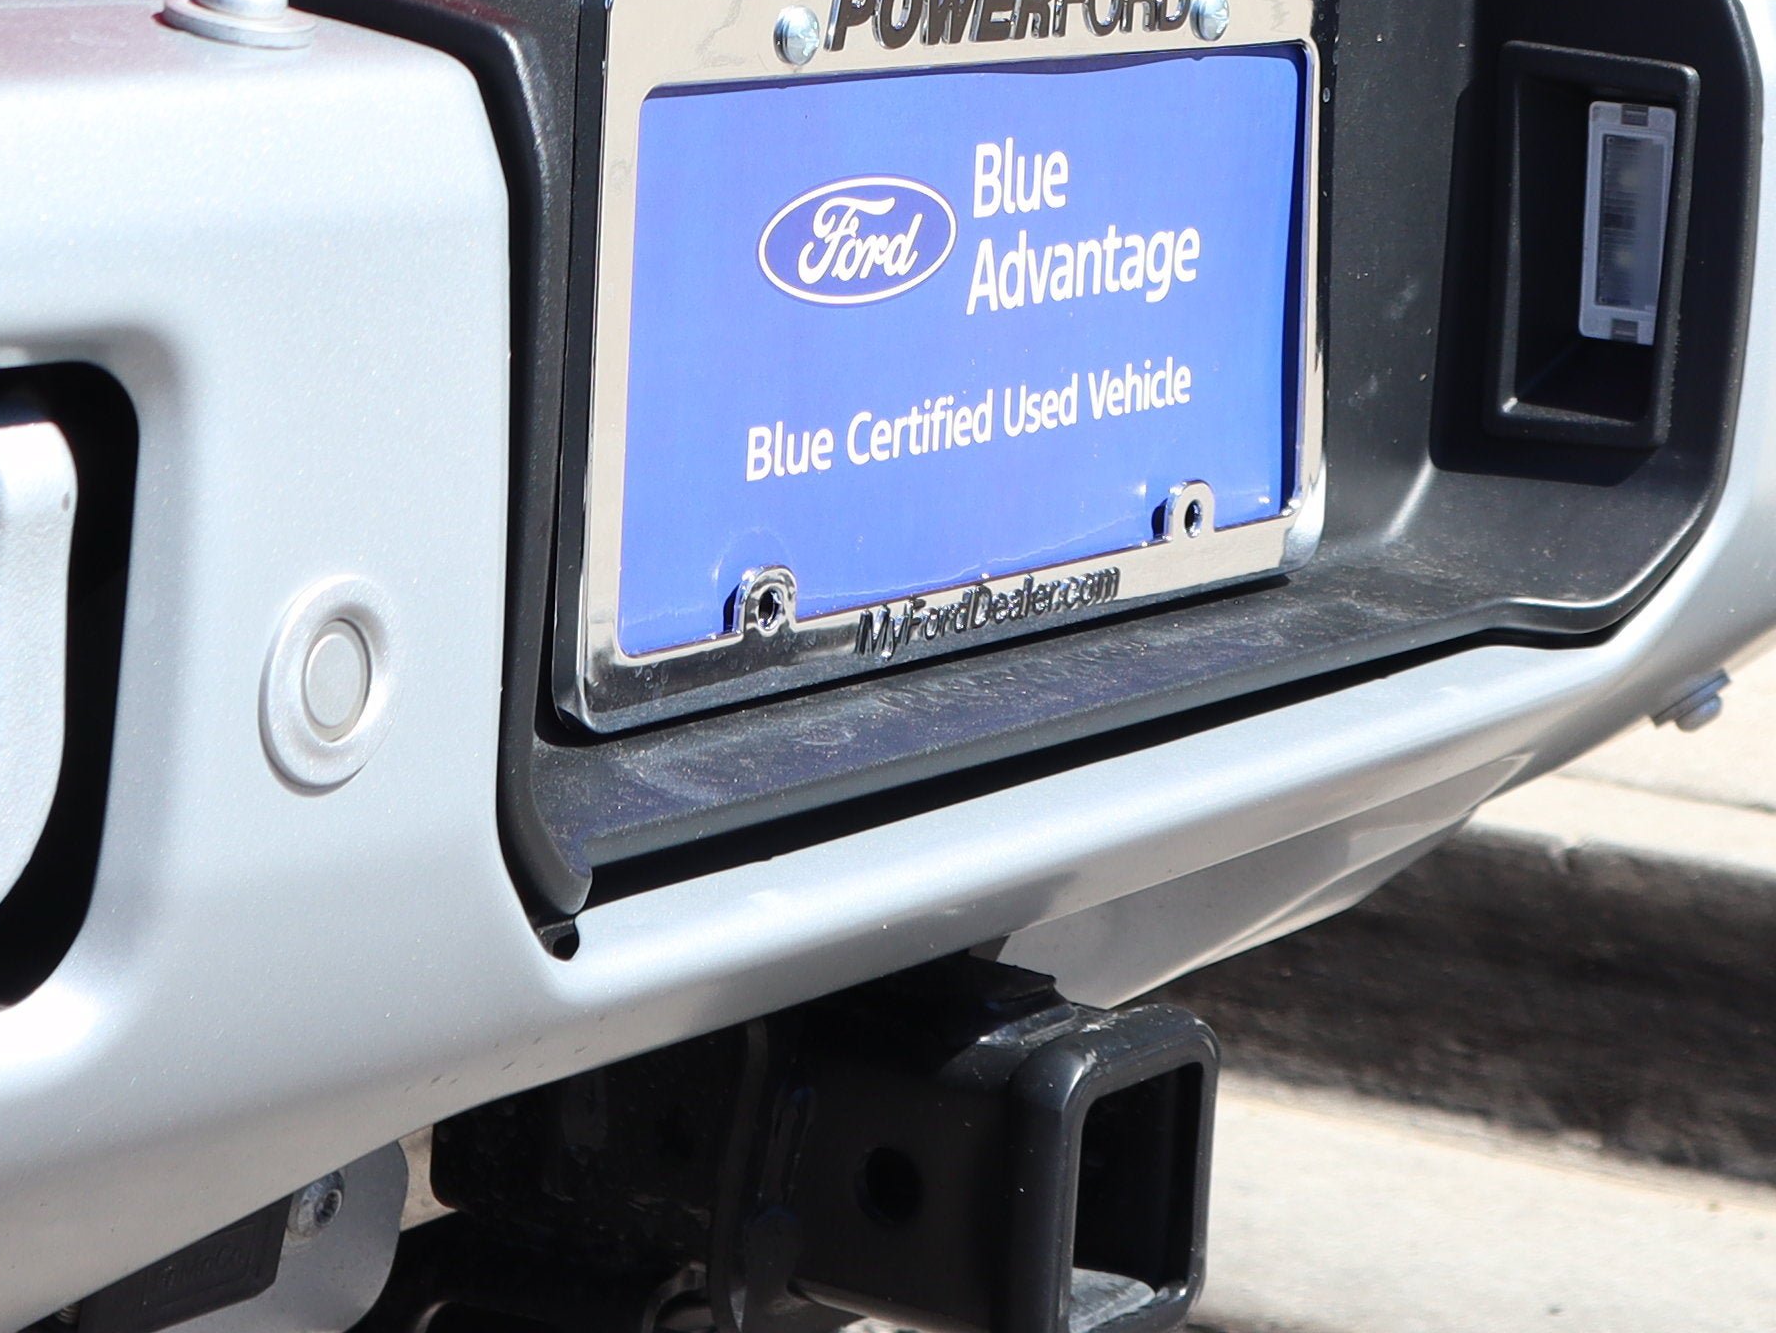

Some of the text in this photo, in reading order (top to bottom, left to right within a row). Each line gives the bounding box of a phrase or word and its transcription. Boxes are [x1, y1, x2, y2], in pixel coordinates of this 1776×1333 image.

[973, 136, 1070, 219] Blue
[797, 196, 924, 282] Ford
[966, 223, 1201, 316] Advantage
[745, 355, 1192, 482] Blue Certified Used Vehicle
[853, 566, 1121, 661] MyFordDealer.com
